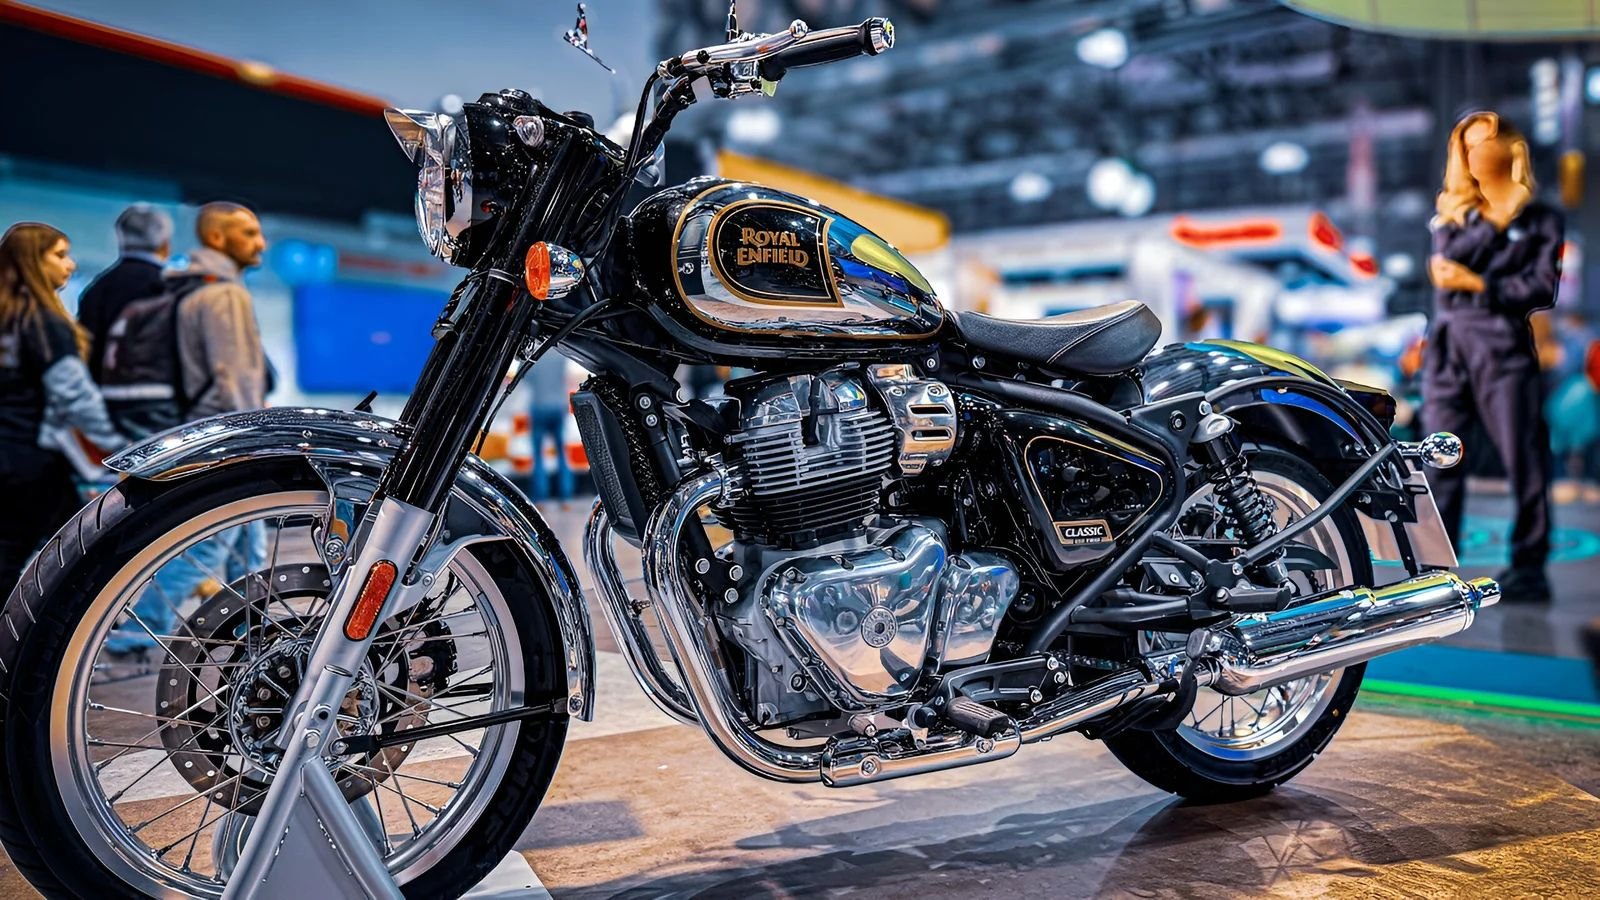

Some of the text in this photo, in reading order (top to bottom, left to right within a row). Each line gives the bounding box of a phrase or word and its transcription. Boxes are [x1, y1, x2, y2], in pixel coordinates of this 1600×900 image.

[741, 227, 801, 247] ROYAL
[737, 247, 809, 268] ENFIELD
[1065, 527, 1103, 537] CLASSIC
